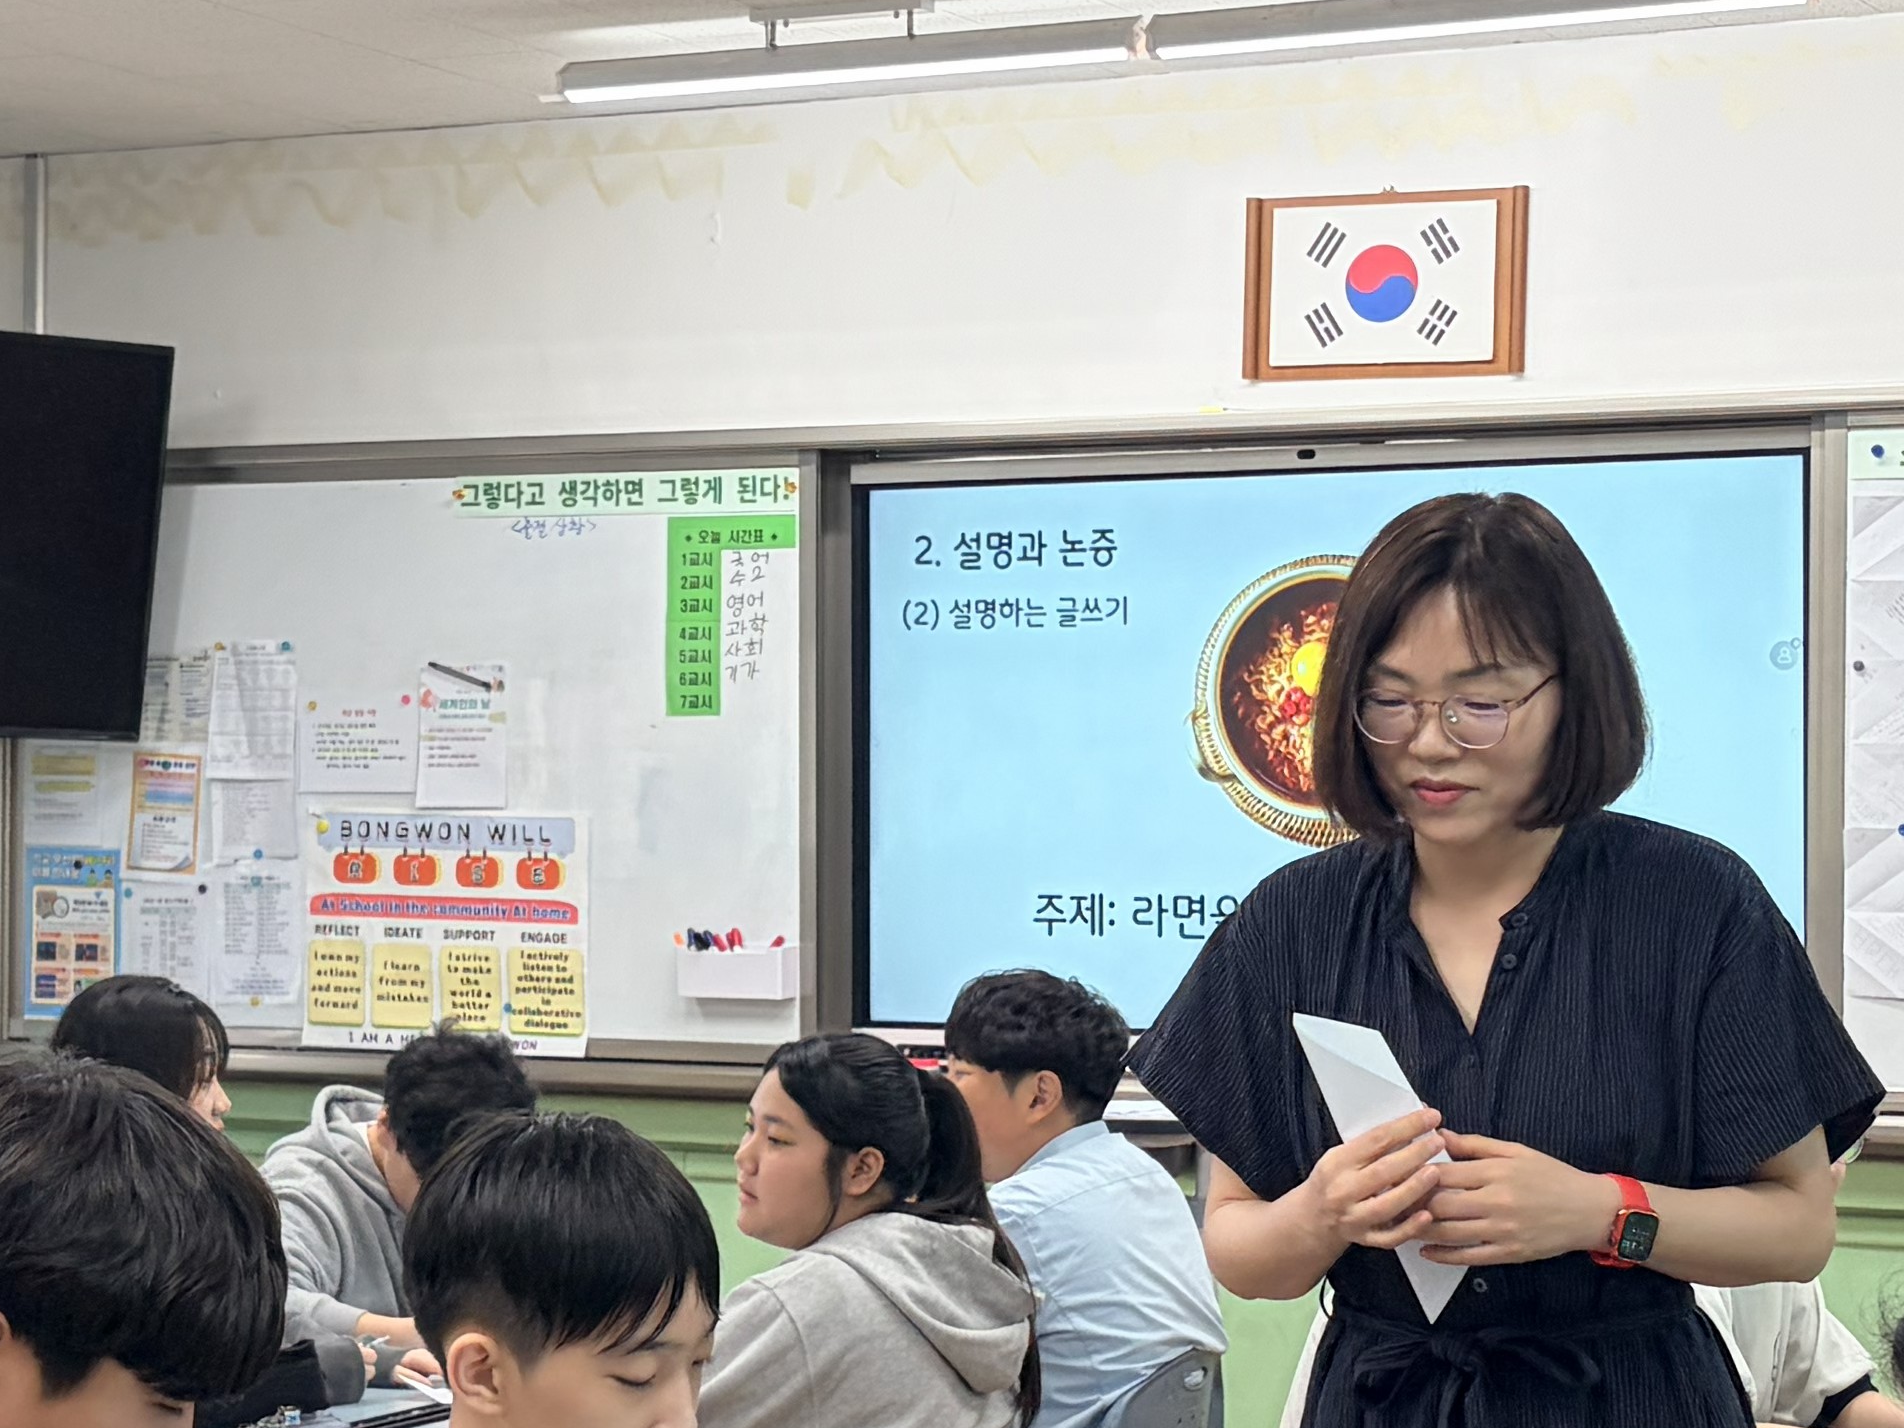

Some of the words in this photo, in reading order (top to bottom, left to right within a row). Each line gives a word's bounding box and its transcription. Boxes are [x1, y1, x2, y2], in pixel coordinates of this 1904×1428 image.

[460, 481, 545, 509] 그렇다고
[558, 479, 644, 507] 생각하면
[657, 477, 723, 505] 그렇게
[737, 475, 791, 503] 된다!
[698, 529, 721, 544] 오늘
[728, 529, 764, 544] 시간표
[914, 535, 941, 567] 2.
[953, 530, 1048, 570] 설명과
[1058, 529, 1117, 567] 논증
[682, 552, 713, 567] 1교시
[680, 575, 713, 590] 2교시
[680, 598, 713, 613] 3교시
[726, 591, 764, 617] 영어
[902, 599, 939, 630] (2)
[949, 597, 1047, 629] 설명하는
[1056, 596, 1127, 628] 글쓰기
[725, 612, 769, 636] 과학
[679, 626, 712, 641] 4교시
[724, 638, 763, 657] 사회
[679, 649, 712, 664] 5교시
[679, 672, 712, 687] 6교시
[680, 694, 712, 710] 7교시
[341, 820, 470, 840] BONGWON
[487, 824, 551, 842] WILL
[340, 898, 384, 912] School
[430, 903, 507, 919] community
[533, 907, 570, 919] home
[1033, 893, 1115, 937] 주제:
[315, 924, 360, 937] REFLECT
[384, 927, 423, 939] IDEATE
[443, 928, 495, 942] SUPPORT
[521, 932, 567, 944] ENGAGE
[526, 951, 569, 963] actively
[316, 968, 357, 978] actions
[390, 961, 420, 971] learn
[462, 964, 491, 974] make
[523, 962, 553, 972] listen
[379, 976, 407, 986] from
[460, 977, 480, 986] the
[517, 974, 552, 983] others
[311, 983, 331, 993] and
[450, 989, 482, 999] world
[515, 985, 575, 996] participate
[314, 998, 358, 1010] forward
[376, 992, 429, 1003] mistakes
[451, 1000, 489, 1010] better
[512, 1007, 581, 1018] collaborative
[524, 1019, 568, 1030] dialogue
[361, 1033, 378, 1044] AM
[385, 1034, 393, 1044] A
